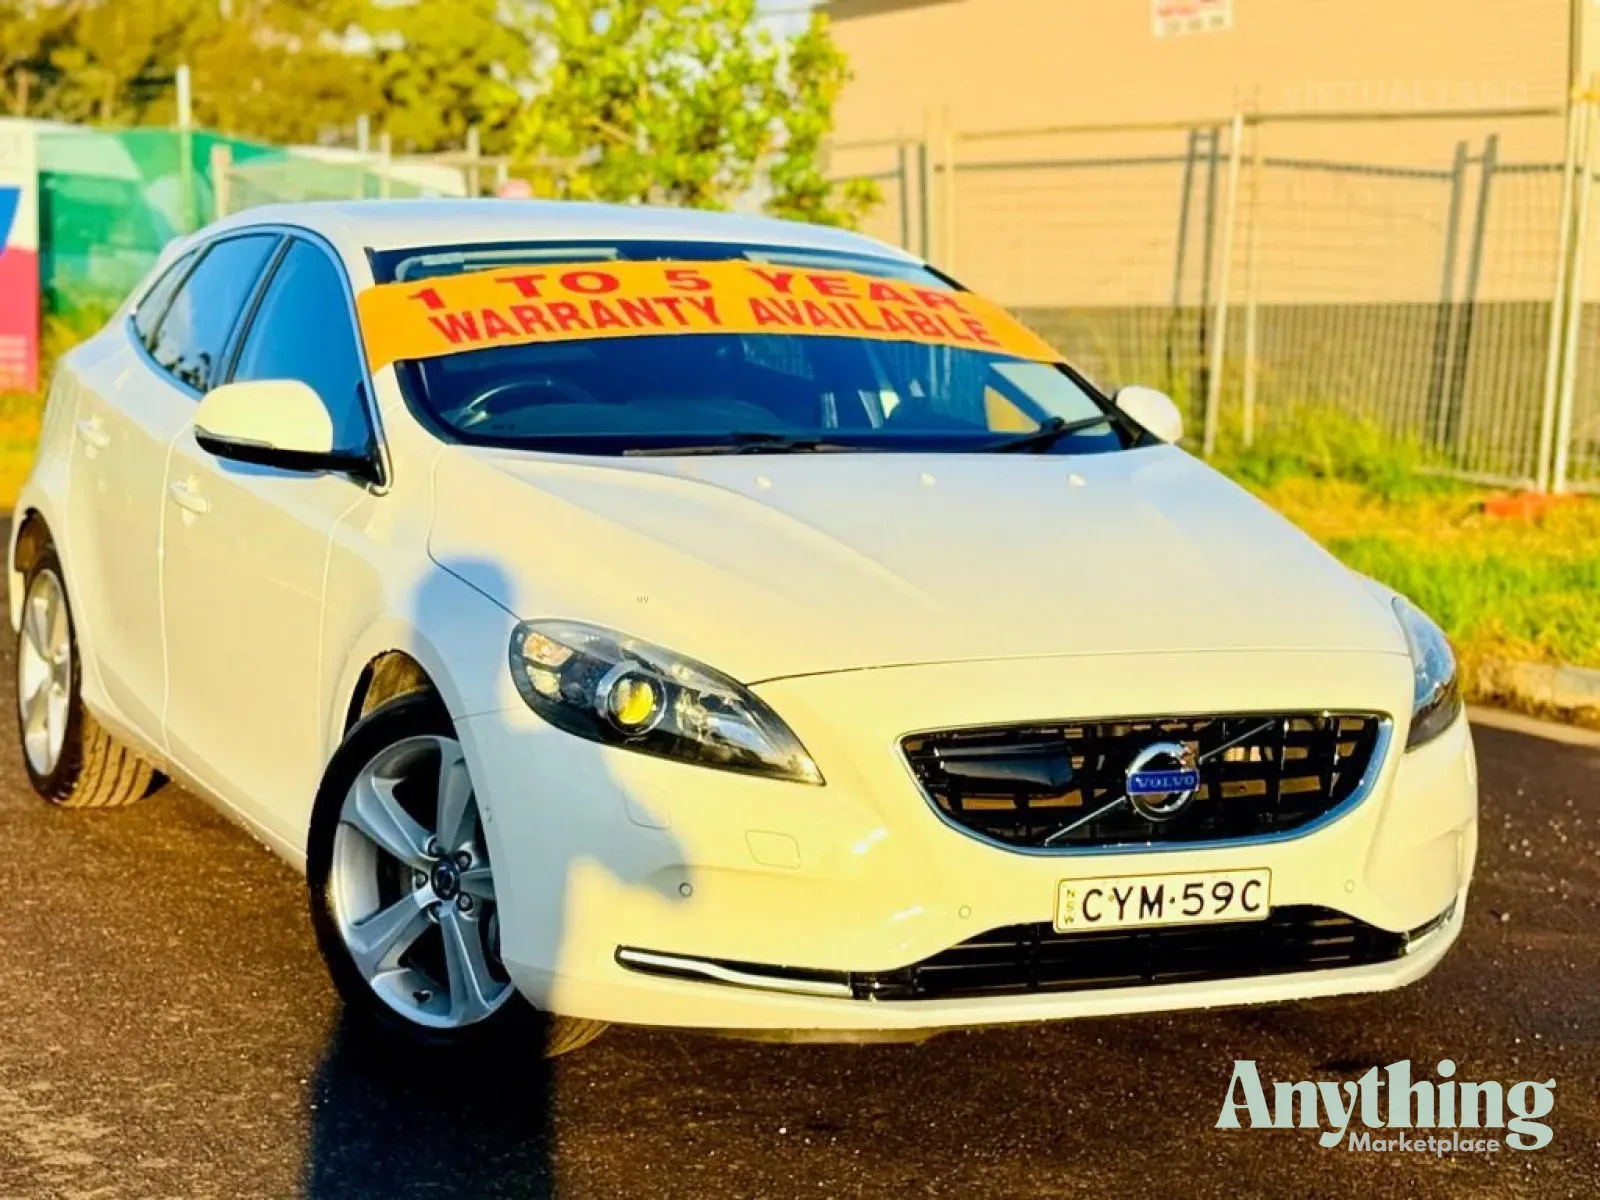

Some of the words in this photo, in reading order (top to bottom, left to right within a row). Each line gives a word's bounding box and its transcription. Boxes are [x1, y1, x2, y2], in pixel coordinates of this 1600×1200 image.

[407, 287, 448, 310] 1
[495, 270, 621, 299] TO
[664, 269, 713, 292] 5
[746, 267, 971, 314] YEAR
[427, 296, 723, 345] WARRANTY
[748, 297, 1003, 348] AVAILABLE
[1135, 774, 1195, 788] VOLVO
